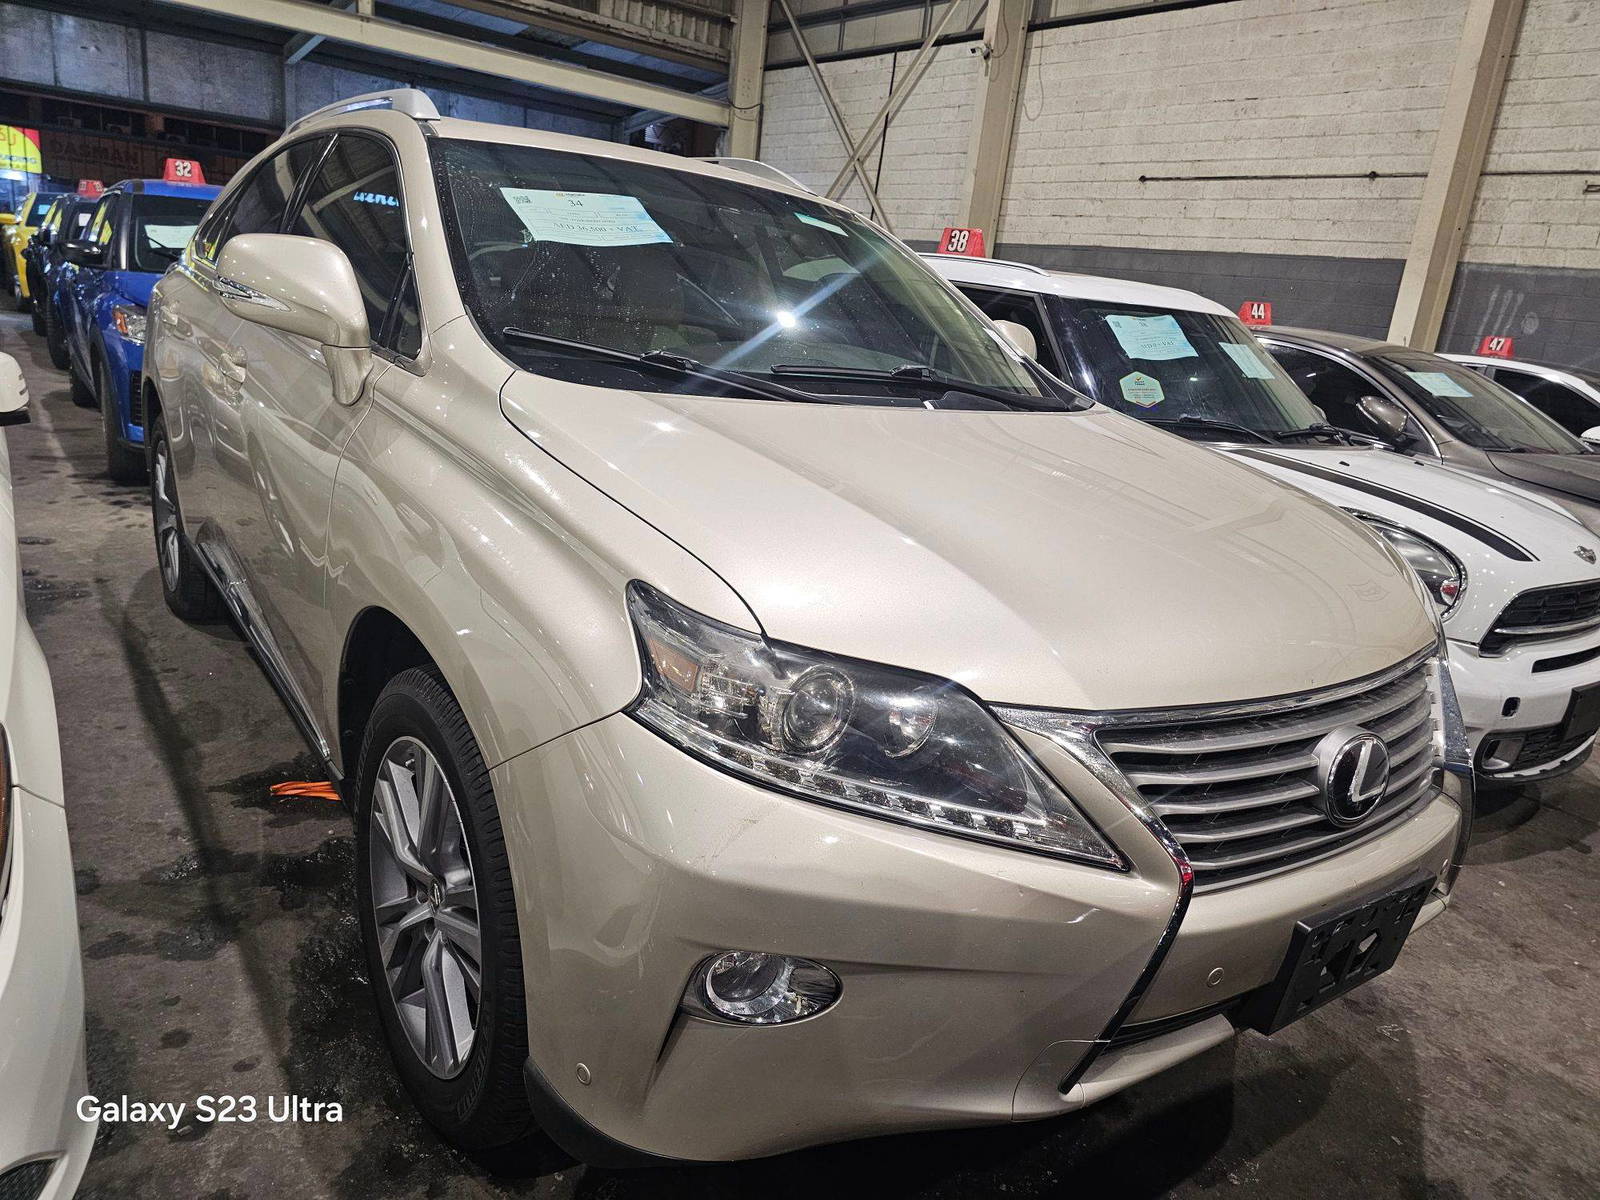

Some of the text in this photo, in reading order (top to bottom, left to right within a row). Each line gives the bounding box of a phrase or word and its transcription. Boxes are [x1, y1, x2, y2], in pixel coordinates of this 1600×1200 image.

[175, 160, 192, 177] 32
[568, 199, 583, 207] 34
[947, 229, 970, 252] 38
[1251, 303, 1265, 319] 44
[1489, 337, 1505, 351] 47
